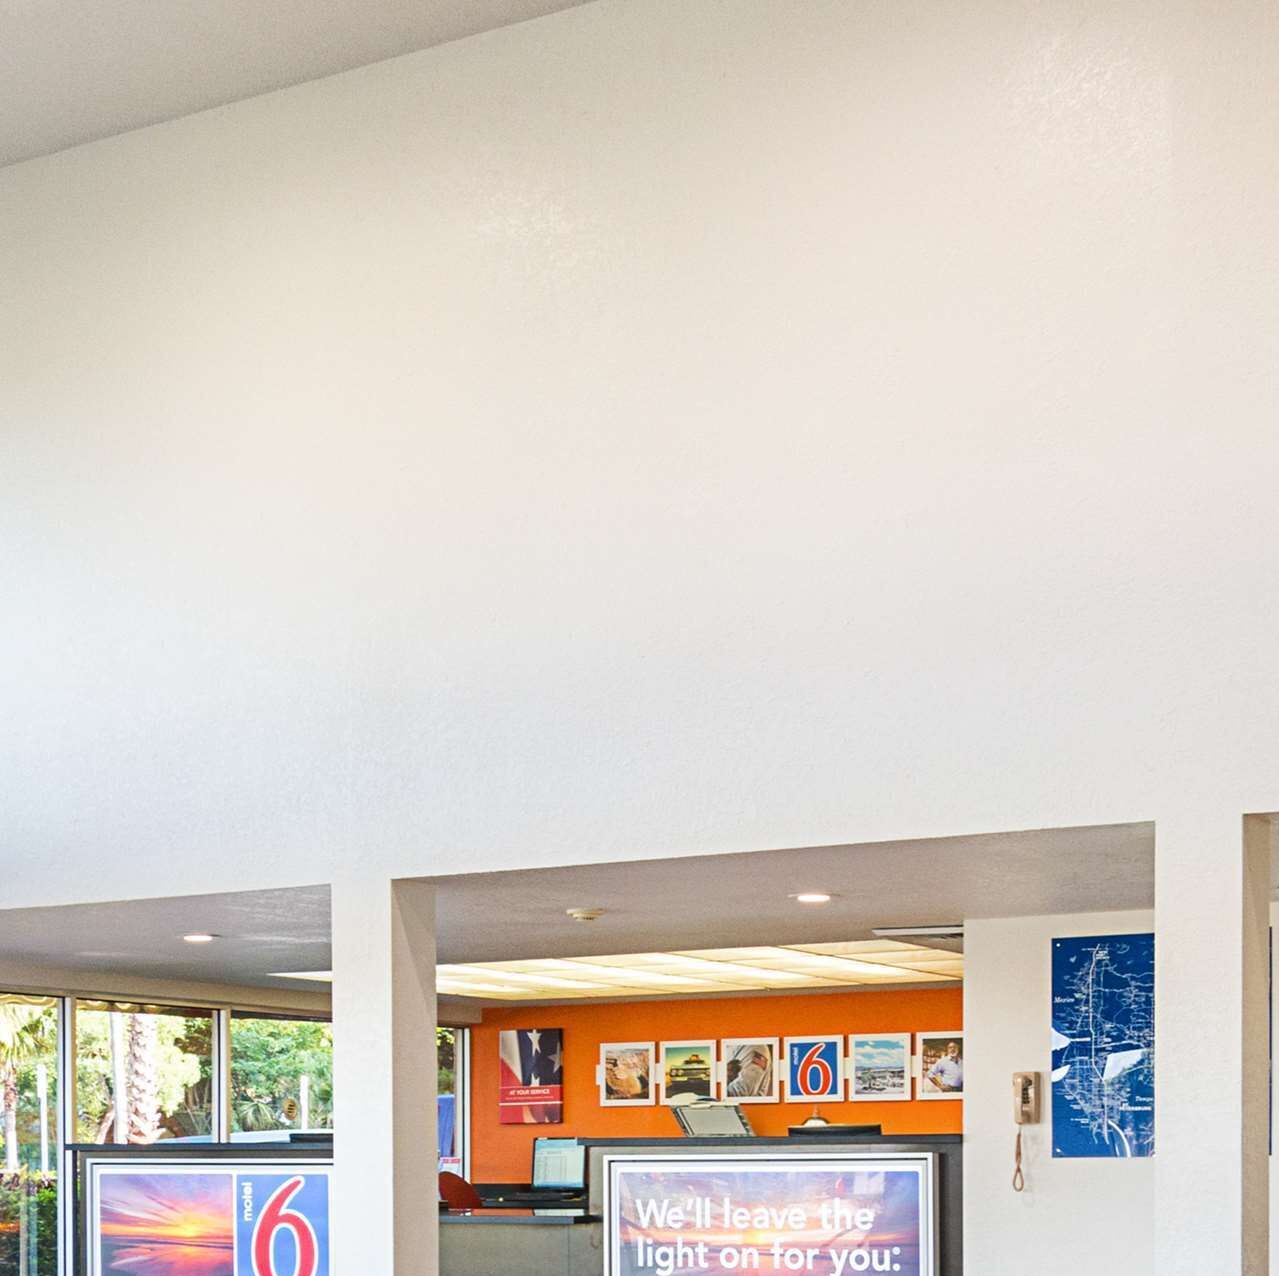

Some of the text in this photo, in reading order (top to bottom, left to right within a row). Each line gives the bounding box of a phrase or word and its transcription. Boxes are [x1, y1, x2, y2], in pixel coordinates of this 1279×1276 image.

[797, 1043, 832, 1096] 6
[242, 1182, 253, 1222] motel
[635, 1198, 875, 1232] We'll leave the
[636, 1237, 709, 1276] light
[720, 1246, 759, 1269] on
[770, 1239, 819, 1270] for
